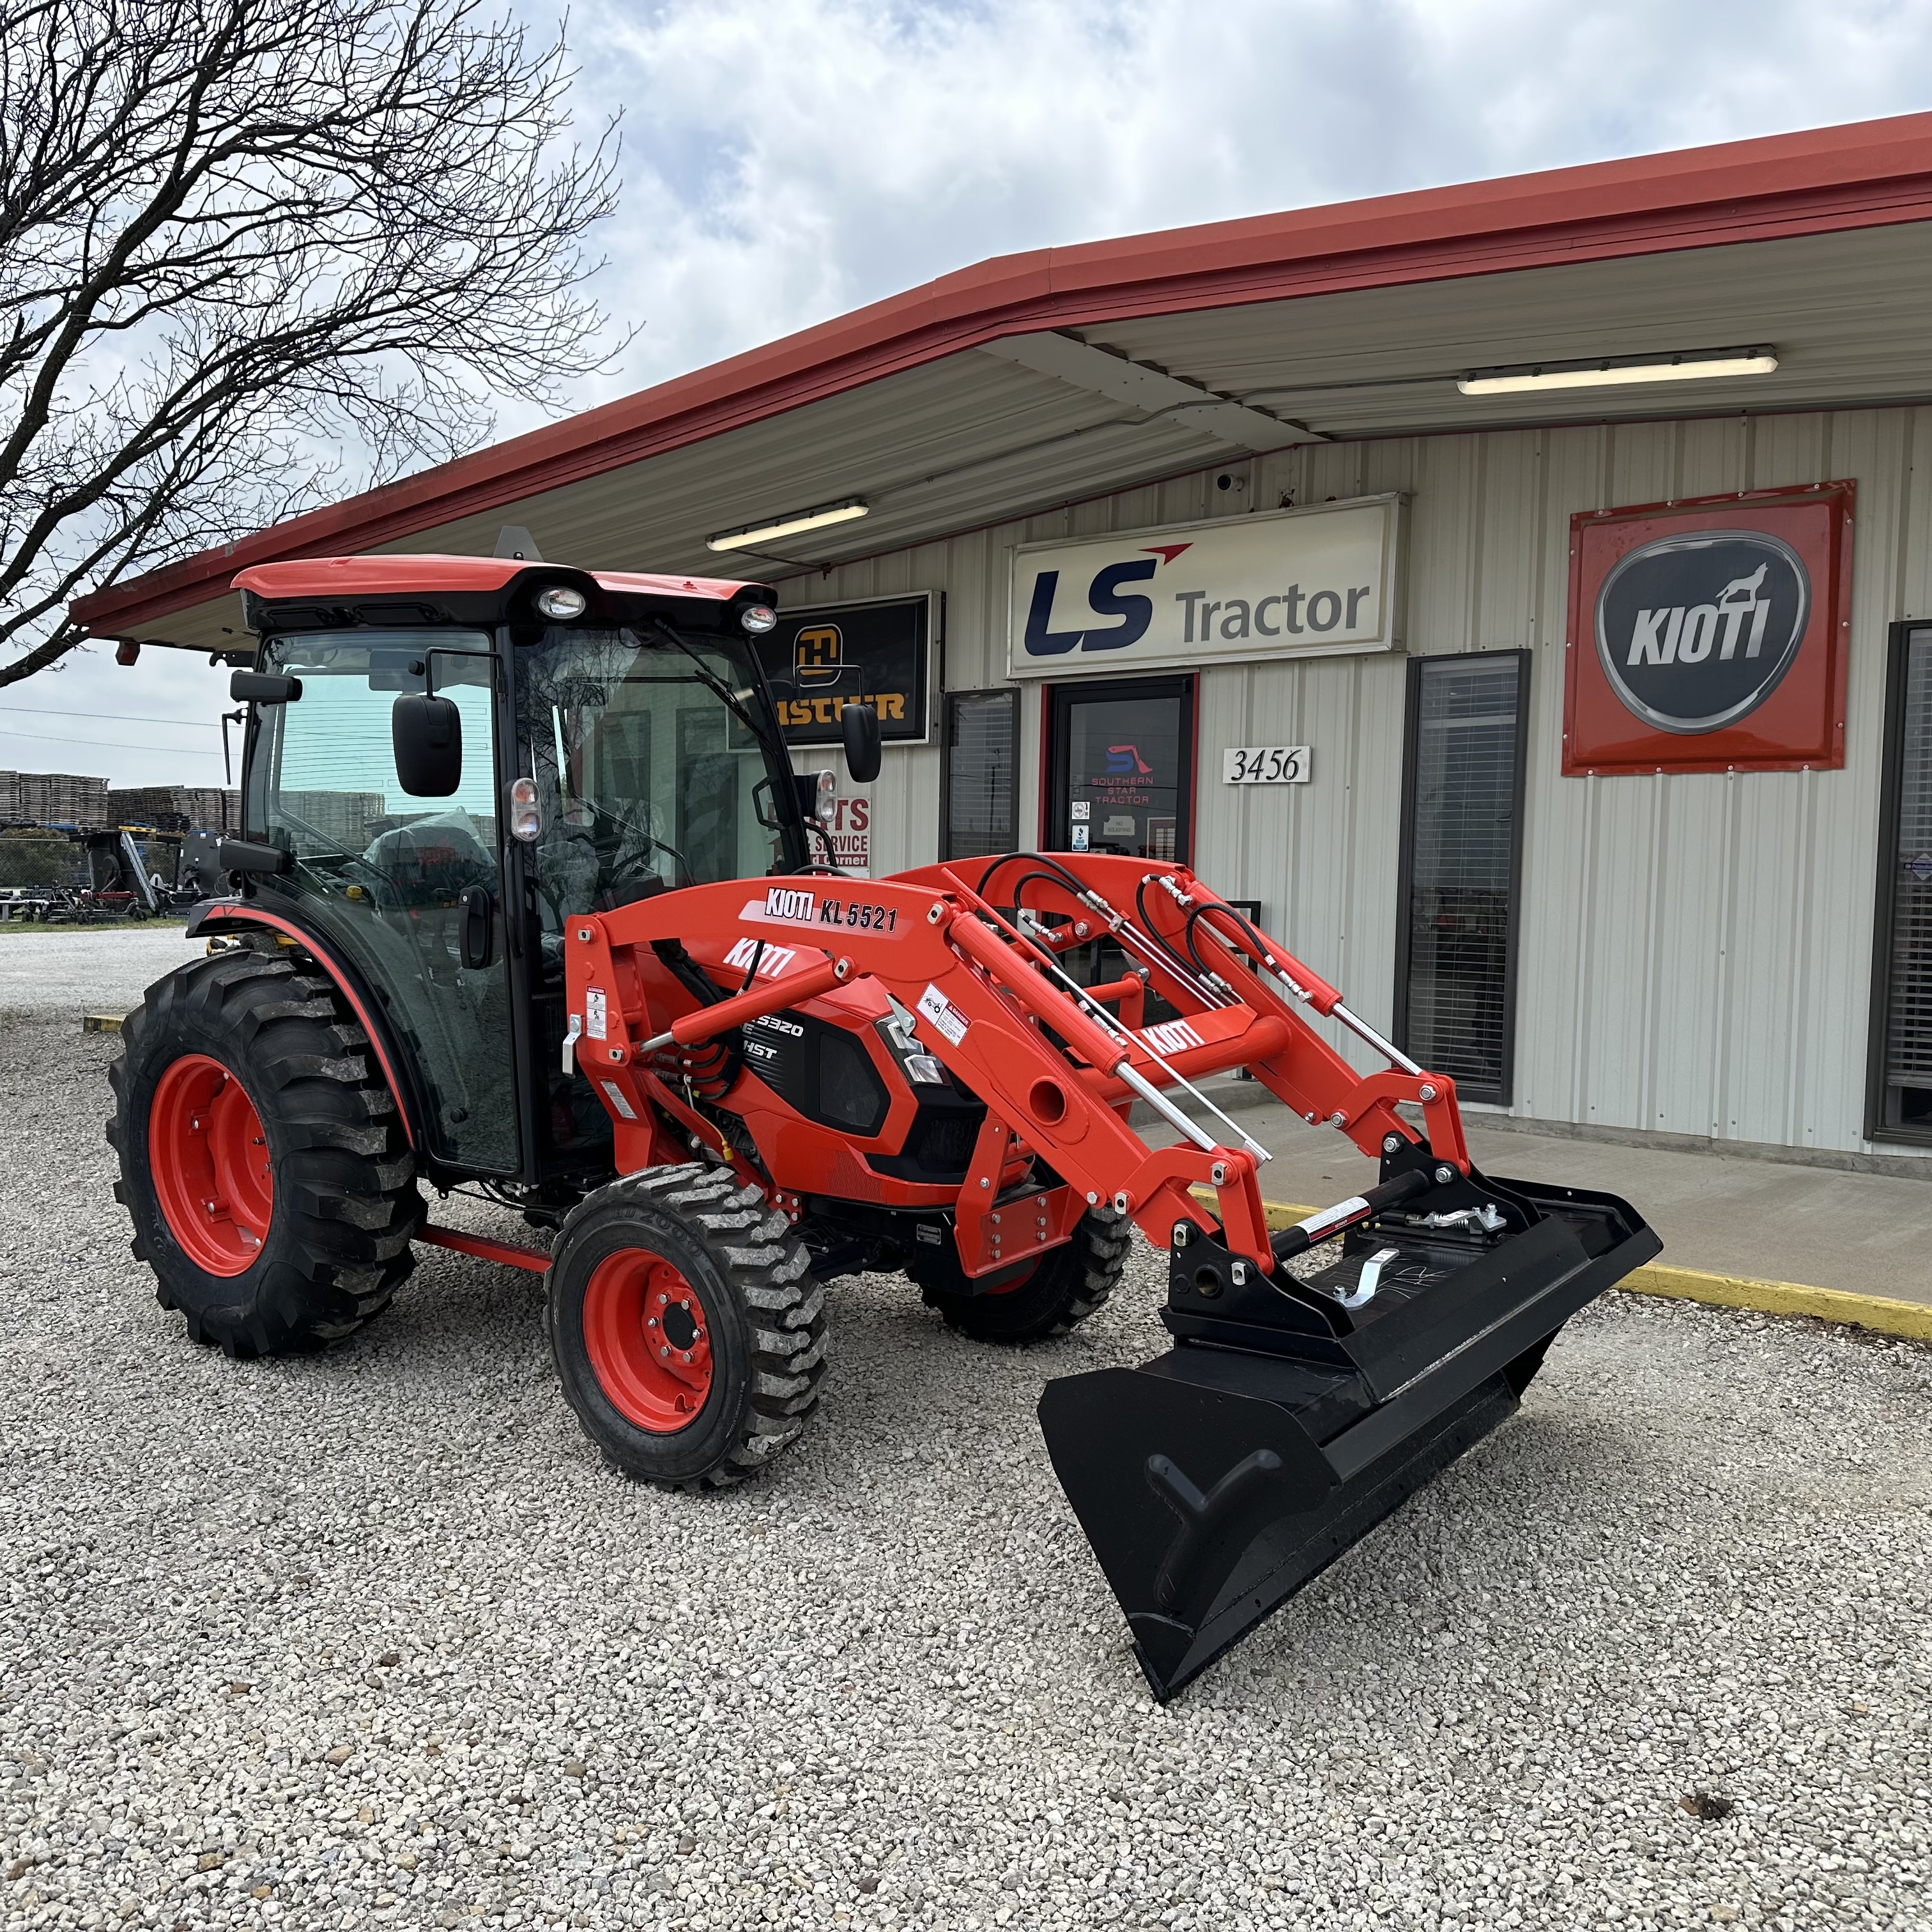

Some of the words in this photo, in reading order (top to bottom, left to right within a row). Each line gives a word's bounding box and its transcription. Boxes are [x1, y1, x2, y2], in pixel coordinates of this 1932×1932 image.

[1024, 558, 1158, 656] LS
[1176, 583, 1370, 643] Tractor
[1626, 599, 1771, 666] KIOTI
[1092, 777, 1153, 786] SOUTHERN
[1231, 749, 1301, 781] 3456
[765, 887, 815, 921] KIOTI
[723, 937, 797, 977] KIOTI
[751, 1015, 804, 1037] 5320
[1140, 1020, 1206, 1055] KIOTI
[743, 1040, 778, 1059] HST
